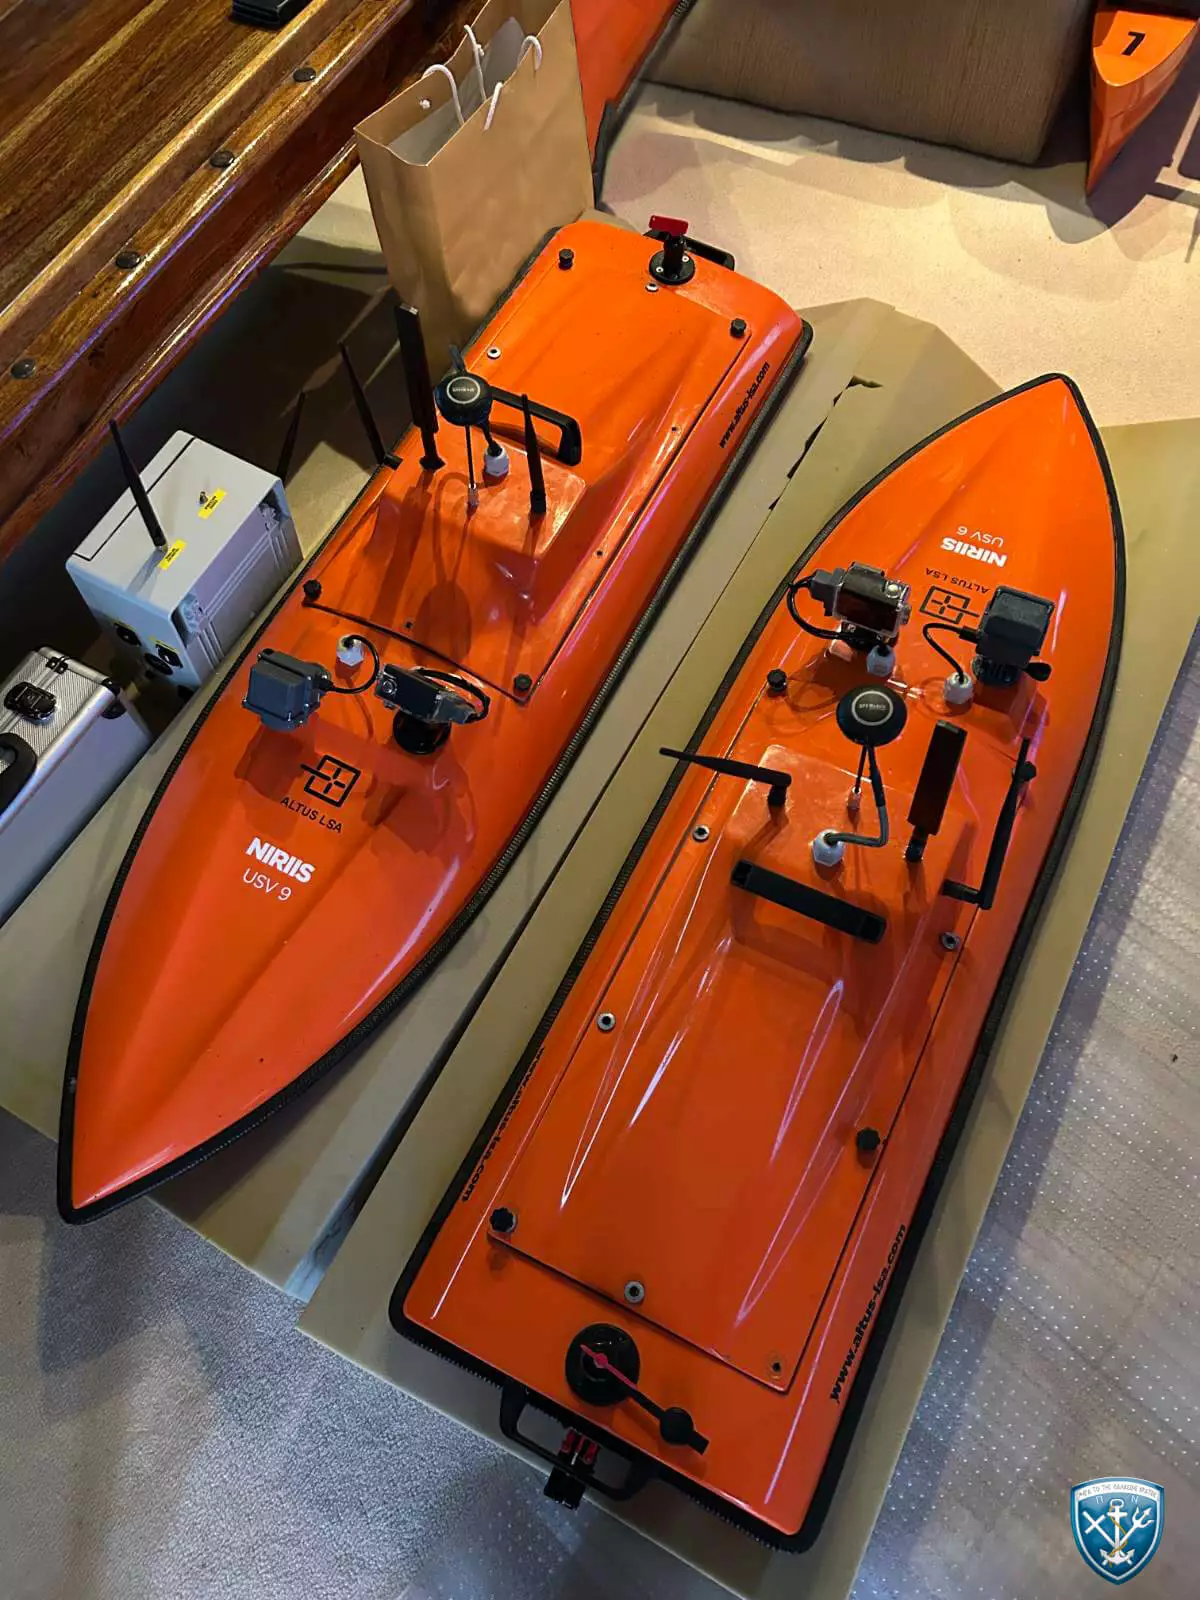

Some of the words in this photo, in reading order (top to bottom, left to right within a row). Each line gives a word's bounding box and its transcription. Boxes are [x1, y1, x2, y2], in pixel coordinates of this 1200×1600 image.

[1121, 31, 1146, 56] 7
[719, 361, 770, 448] www.altus-lsa.com
[956, 526, 968, 536] 6
[969, 532, 1004, 548] USV
[941, 537, 1008, 568] NIRIIS
[925, 567, 949, 581] LSA
[950, 576, 990, 594] ALTUS
[280, 796, 319, 821] ALTUS
[318, 815, 343, 834] LSA
[245, 837, 316, 884] NIRIIS
[243, 867, 279, 893] USV
[278, 886, 292, 901] 9
[830, 1223, 906, 1402] www.altus-lsa.com
